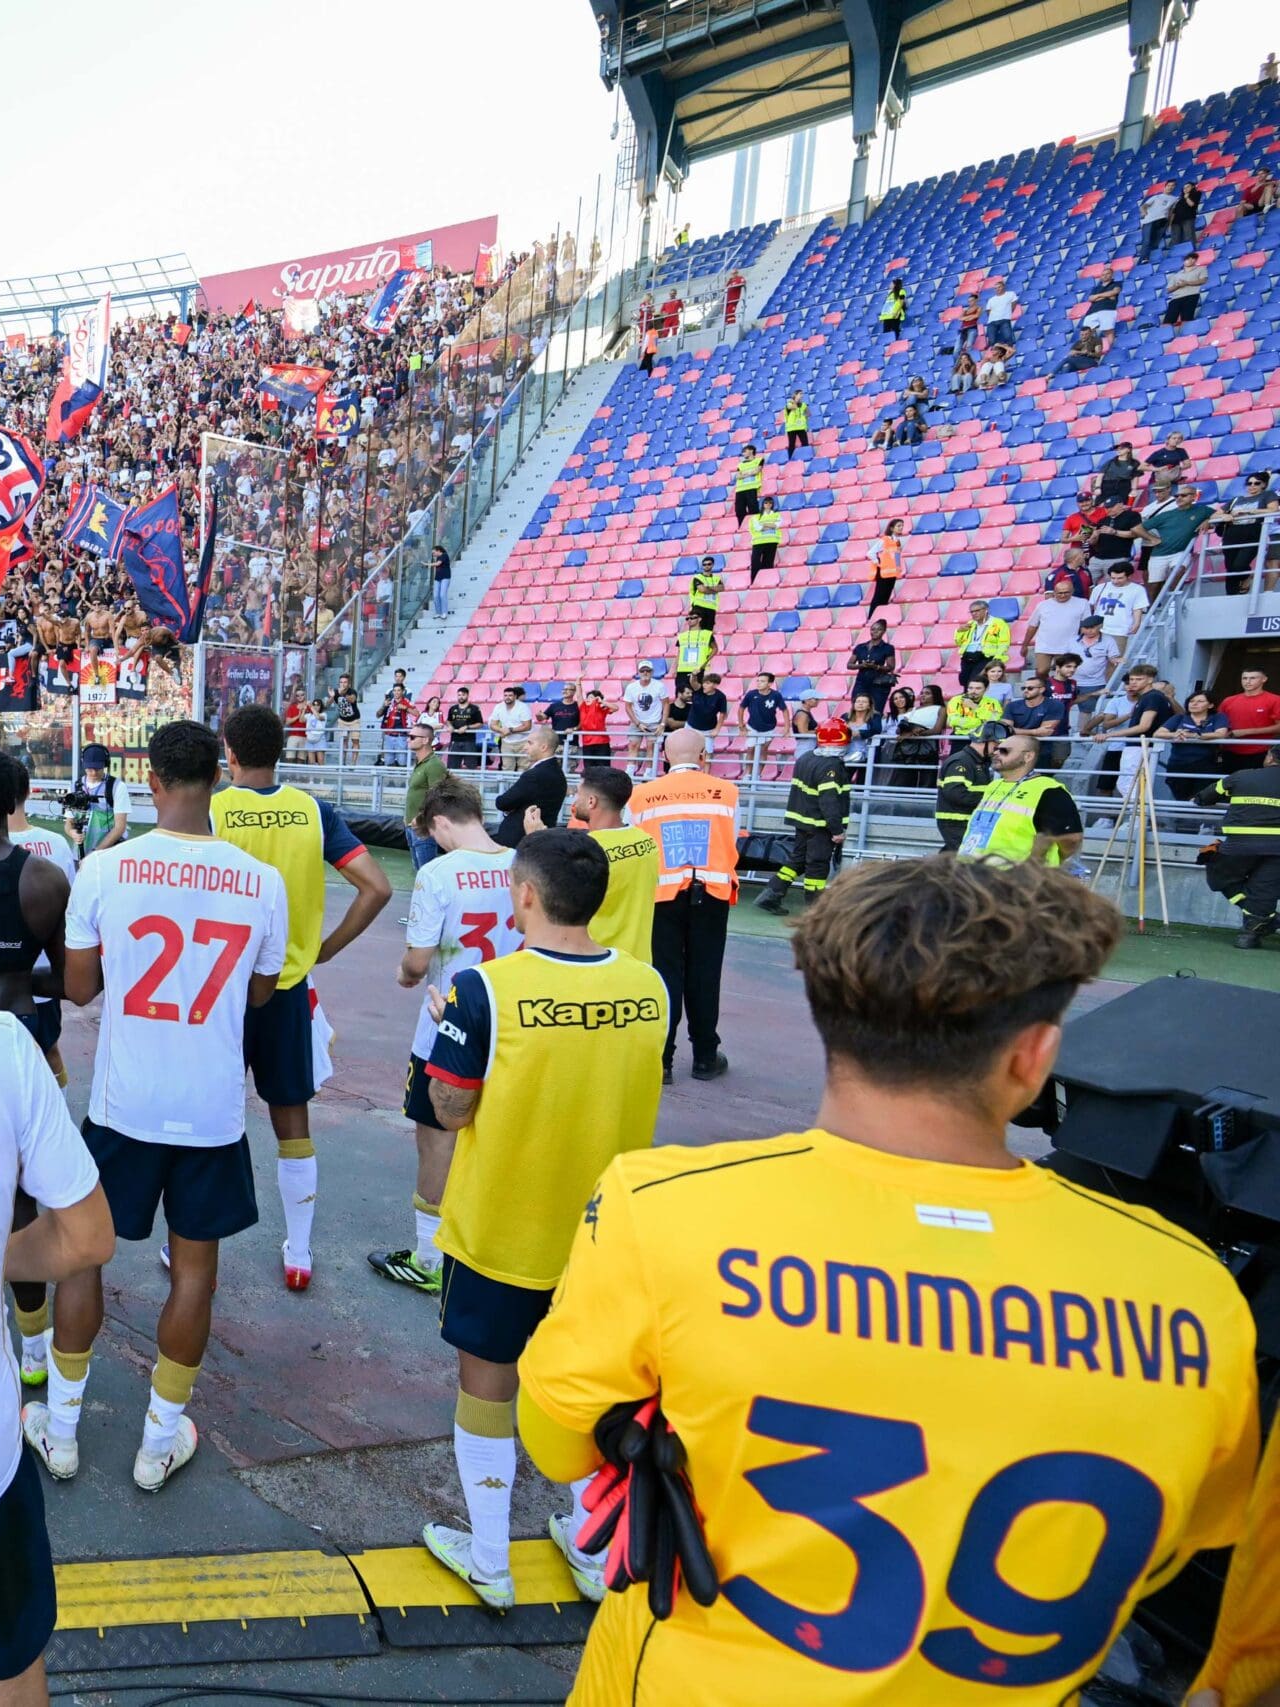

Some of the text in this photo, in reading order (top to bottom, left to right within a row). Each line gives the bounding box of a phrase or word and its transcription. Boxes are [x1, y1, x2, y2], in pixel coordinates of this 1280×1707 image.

[88, 693, 108, 701] 1977
[225, 810, 308, 829] Kappa
[118, 858, 261, 899] MARCANDALLI
[123, 914, 252, 1025] 27
[518, 997, 660, 1030] Kappa
[717, 1246, 1210, 1389] SOMMARIVA
[719, 1395, 1165, 1687] 39
